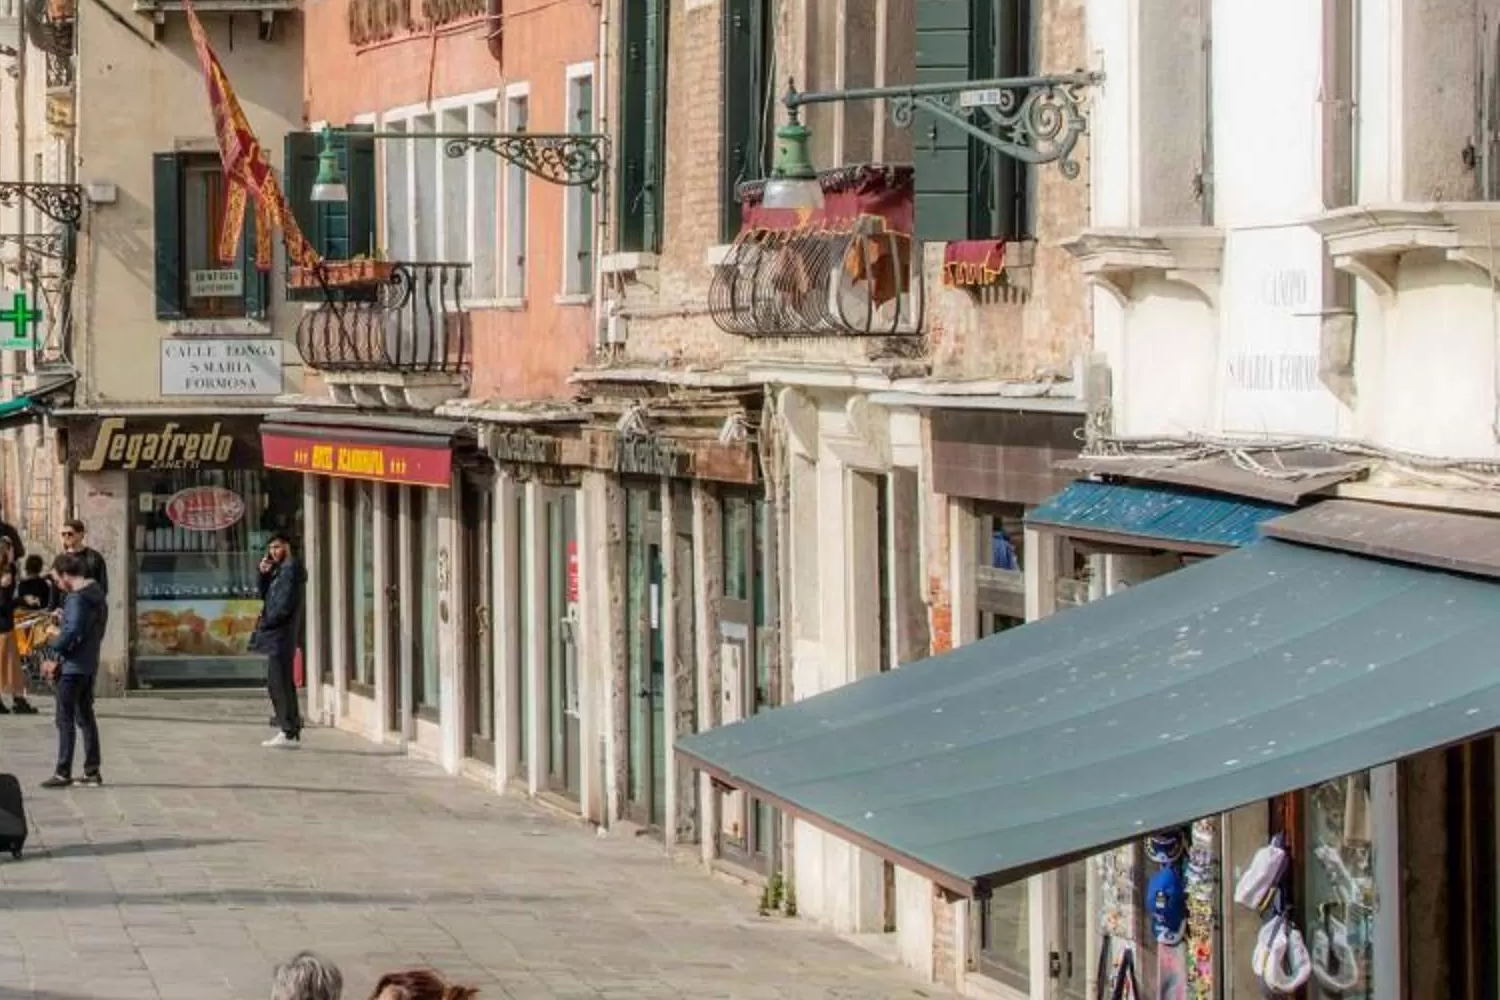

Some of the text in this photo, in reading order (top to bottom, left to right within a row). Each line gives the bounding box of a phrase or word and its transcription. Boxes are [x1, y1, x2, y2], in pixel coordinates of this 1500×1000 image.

[165, 345, 216, 358] CALLE
[203, 361, 252, 374] MARIA
[185, 377, 257, 391] FORMOSA
[78, 417, 234, 472] Segafredo
